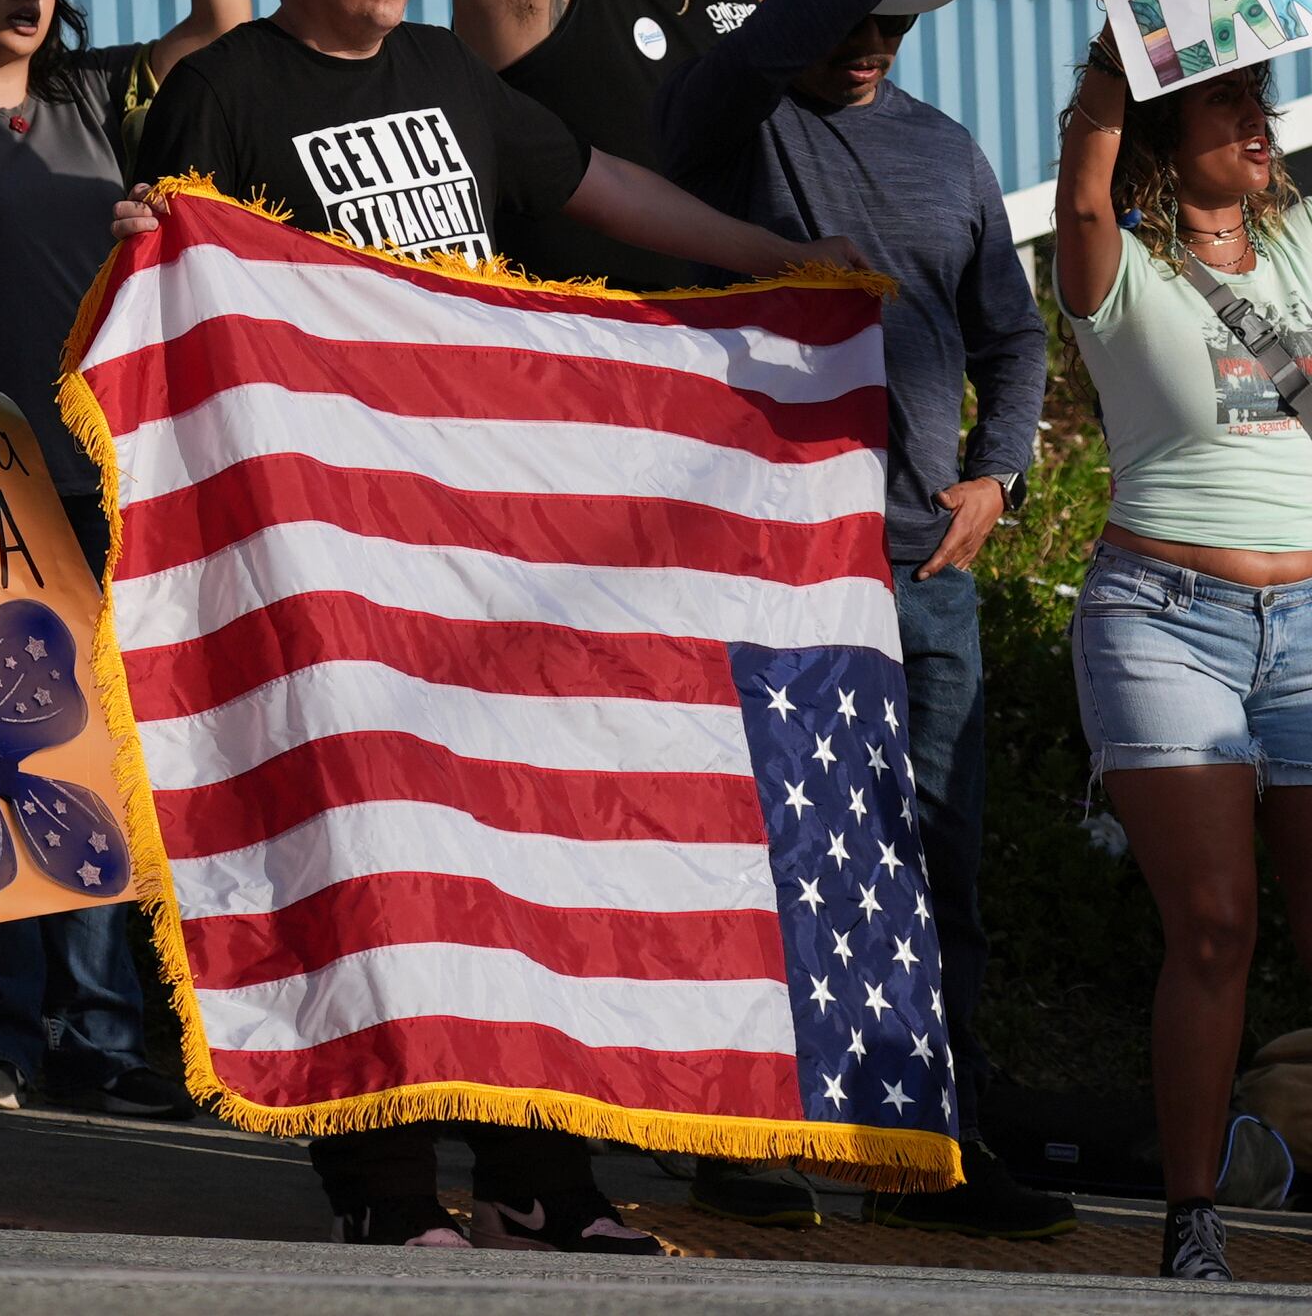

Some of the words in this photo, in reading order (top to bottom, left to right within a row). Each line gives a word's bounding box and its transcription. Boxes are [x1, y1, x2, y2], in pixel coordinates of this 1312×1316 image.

[308, 126, 394, 196] GET
[388, 114, 462, 179] ICE
[338, 181, 479, 251] STRAIGHT
[1228, 423, 1253, 436] rage
[1257, 419, 1292, 435] against
